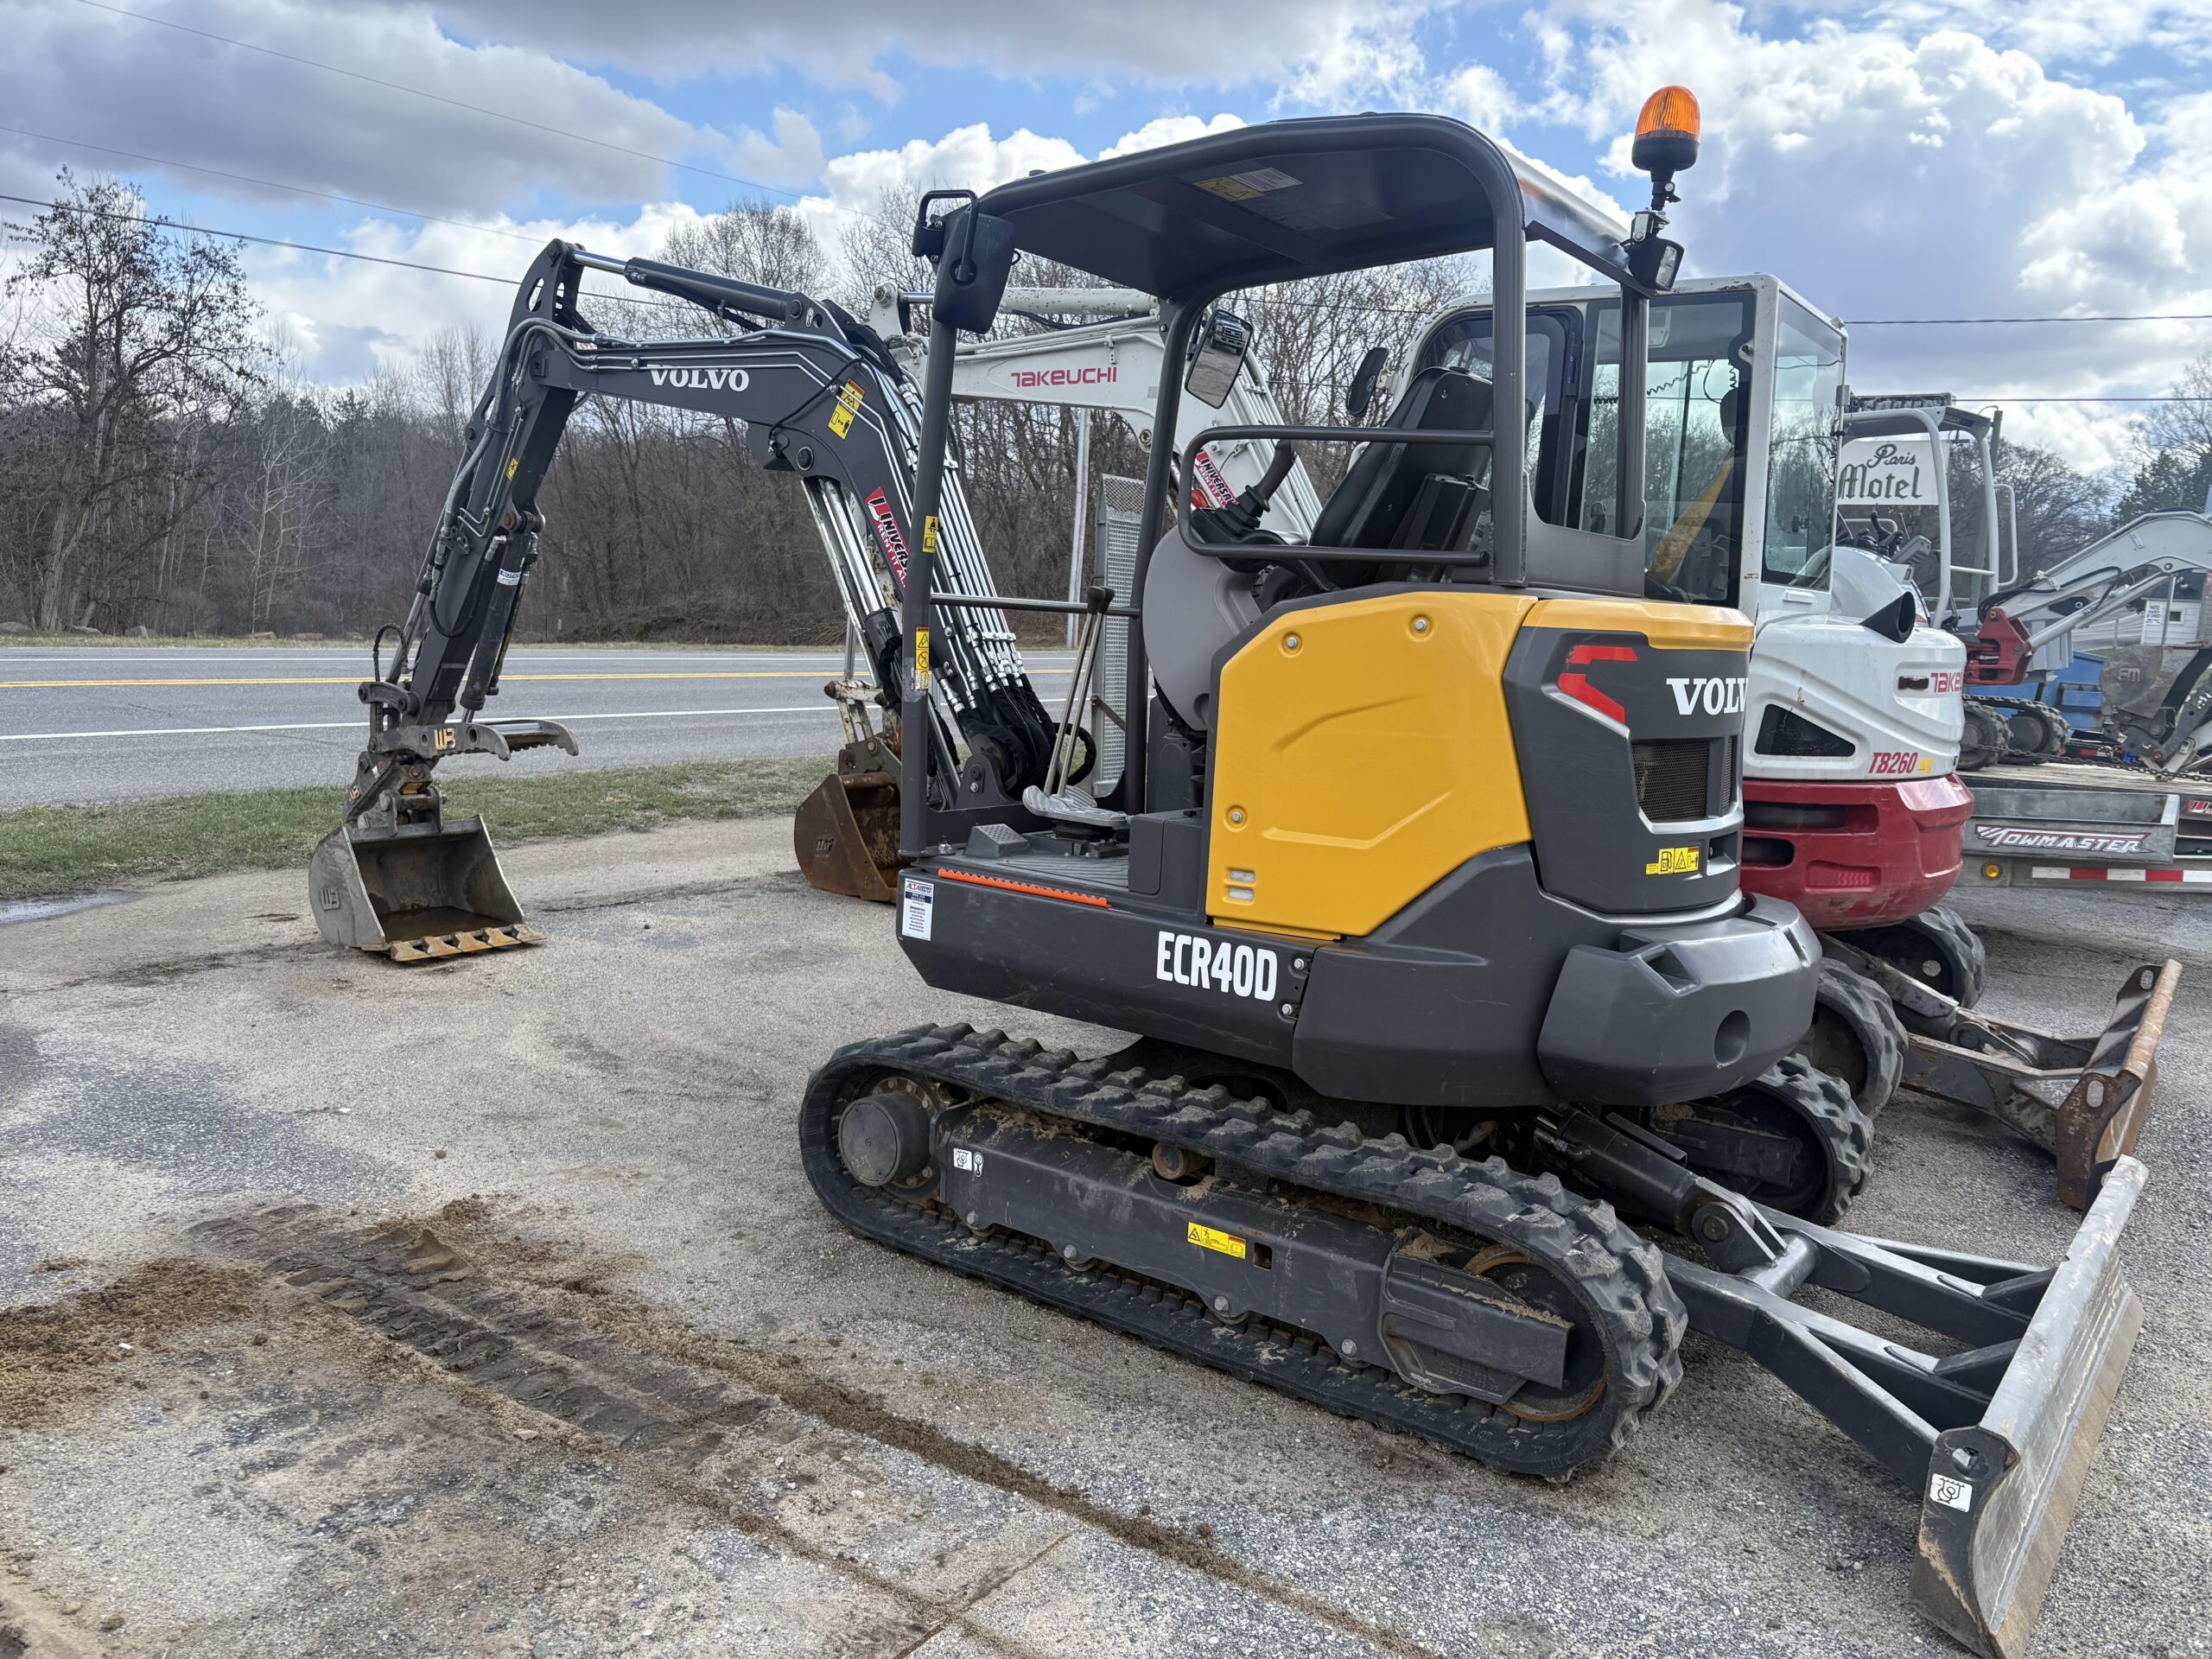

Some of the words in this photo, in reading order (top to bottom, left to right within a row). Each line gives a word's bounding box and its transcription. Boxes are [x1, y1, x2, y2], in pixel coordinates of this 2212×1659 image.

[647, 364, 749, 391] VOLVO
[1010, 366, 1117, 388] TAKEUCHI
[1866, 442, 1916, 468] Paris
[1837, 463, 1923, 499] Motel
[877, 524, 894, 553] RENT
[897, 569, 906, 588] AL
[1666, 677, 1749, 715] VOLV
[1869, 752, 1919, 774] TB260
[1975, 824, 2154, 854] TOWMASTER
[1156, 931, 1278, 1001] ECR40D
